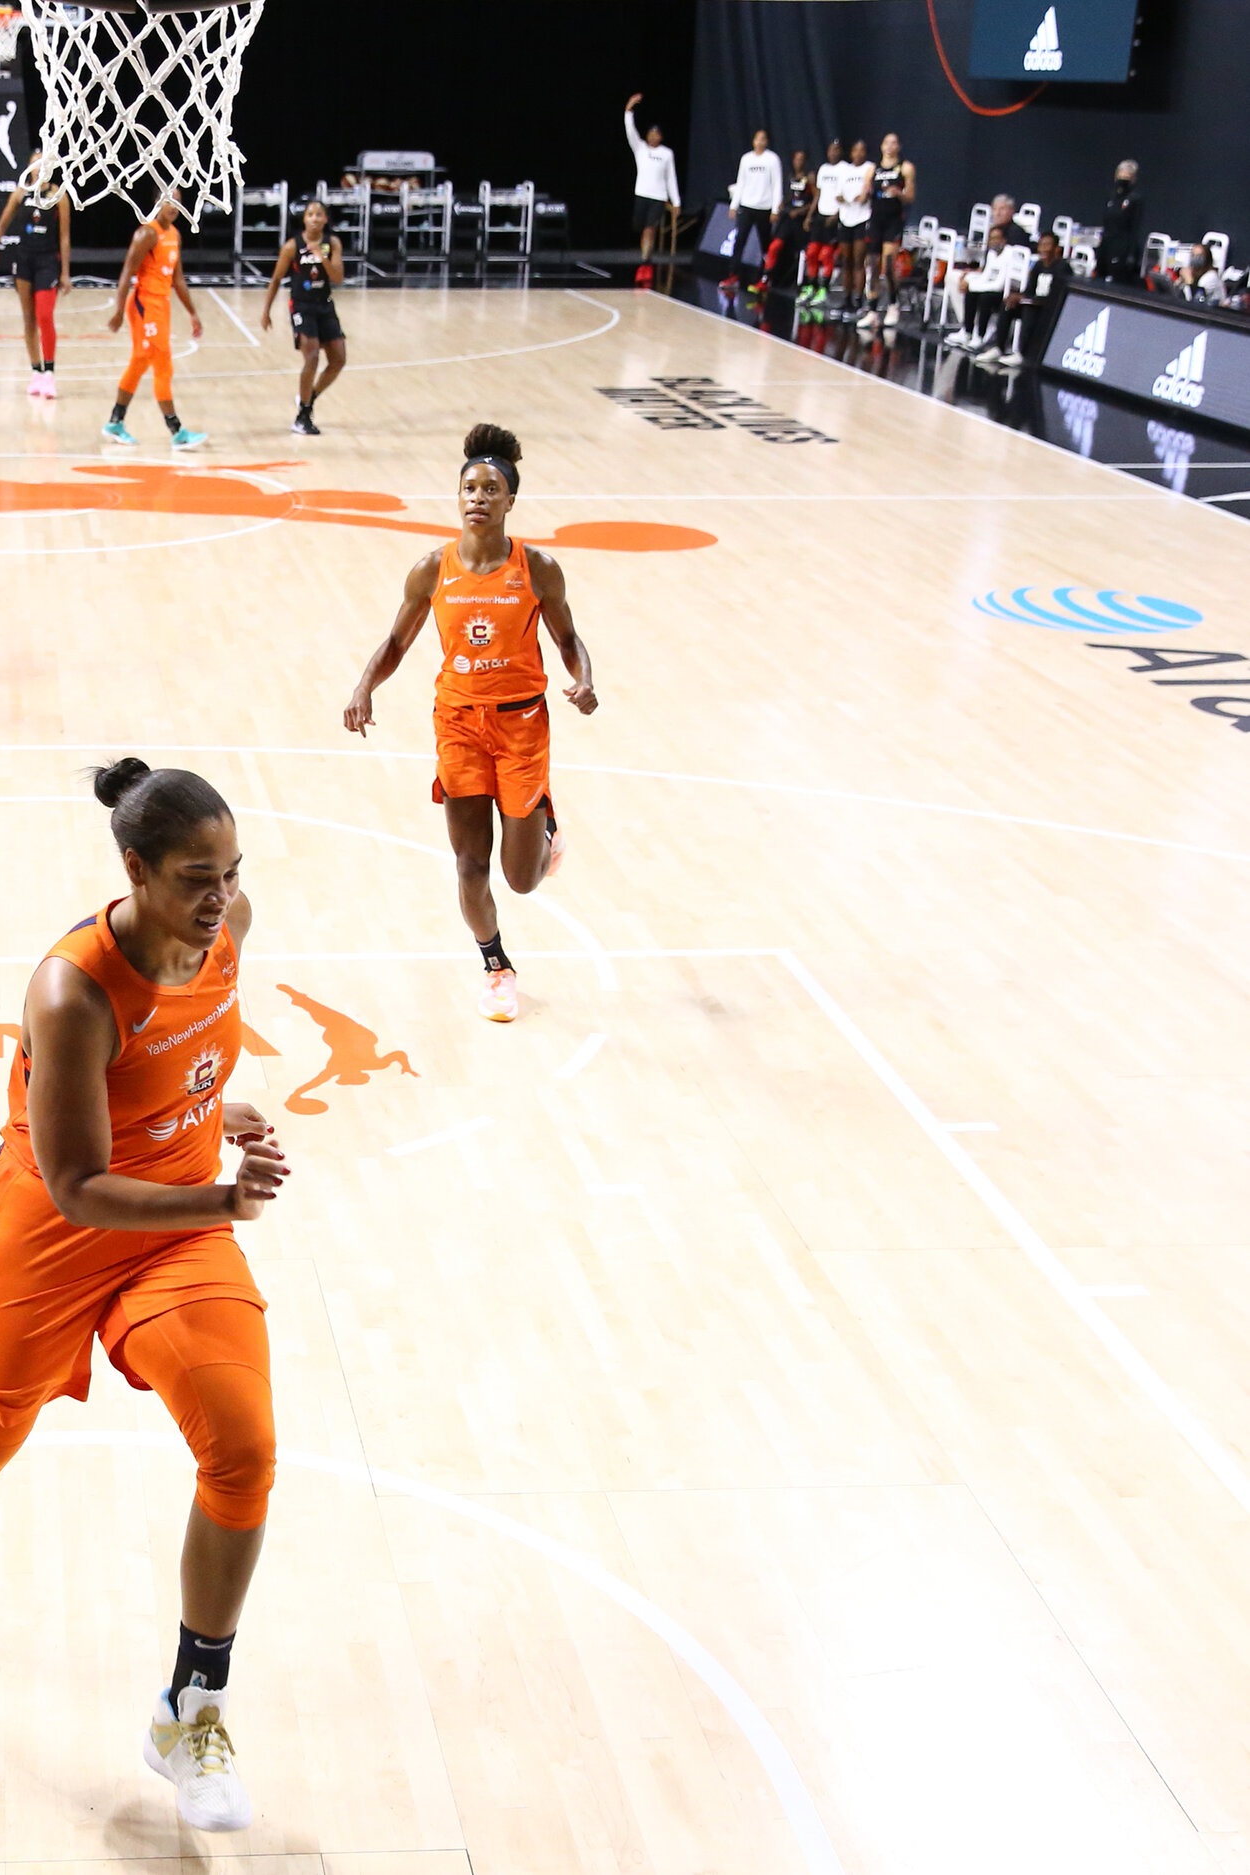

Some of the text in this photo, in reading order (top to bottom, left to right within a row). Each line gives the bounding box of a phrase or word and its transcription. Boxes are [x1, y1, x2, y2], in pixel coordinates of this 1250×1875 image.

[1023, 48, 1063, 71] adidas
[1062, 345, 1107, 378] adidas
[1152, 373, 1206, 408] adidas
